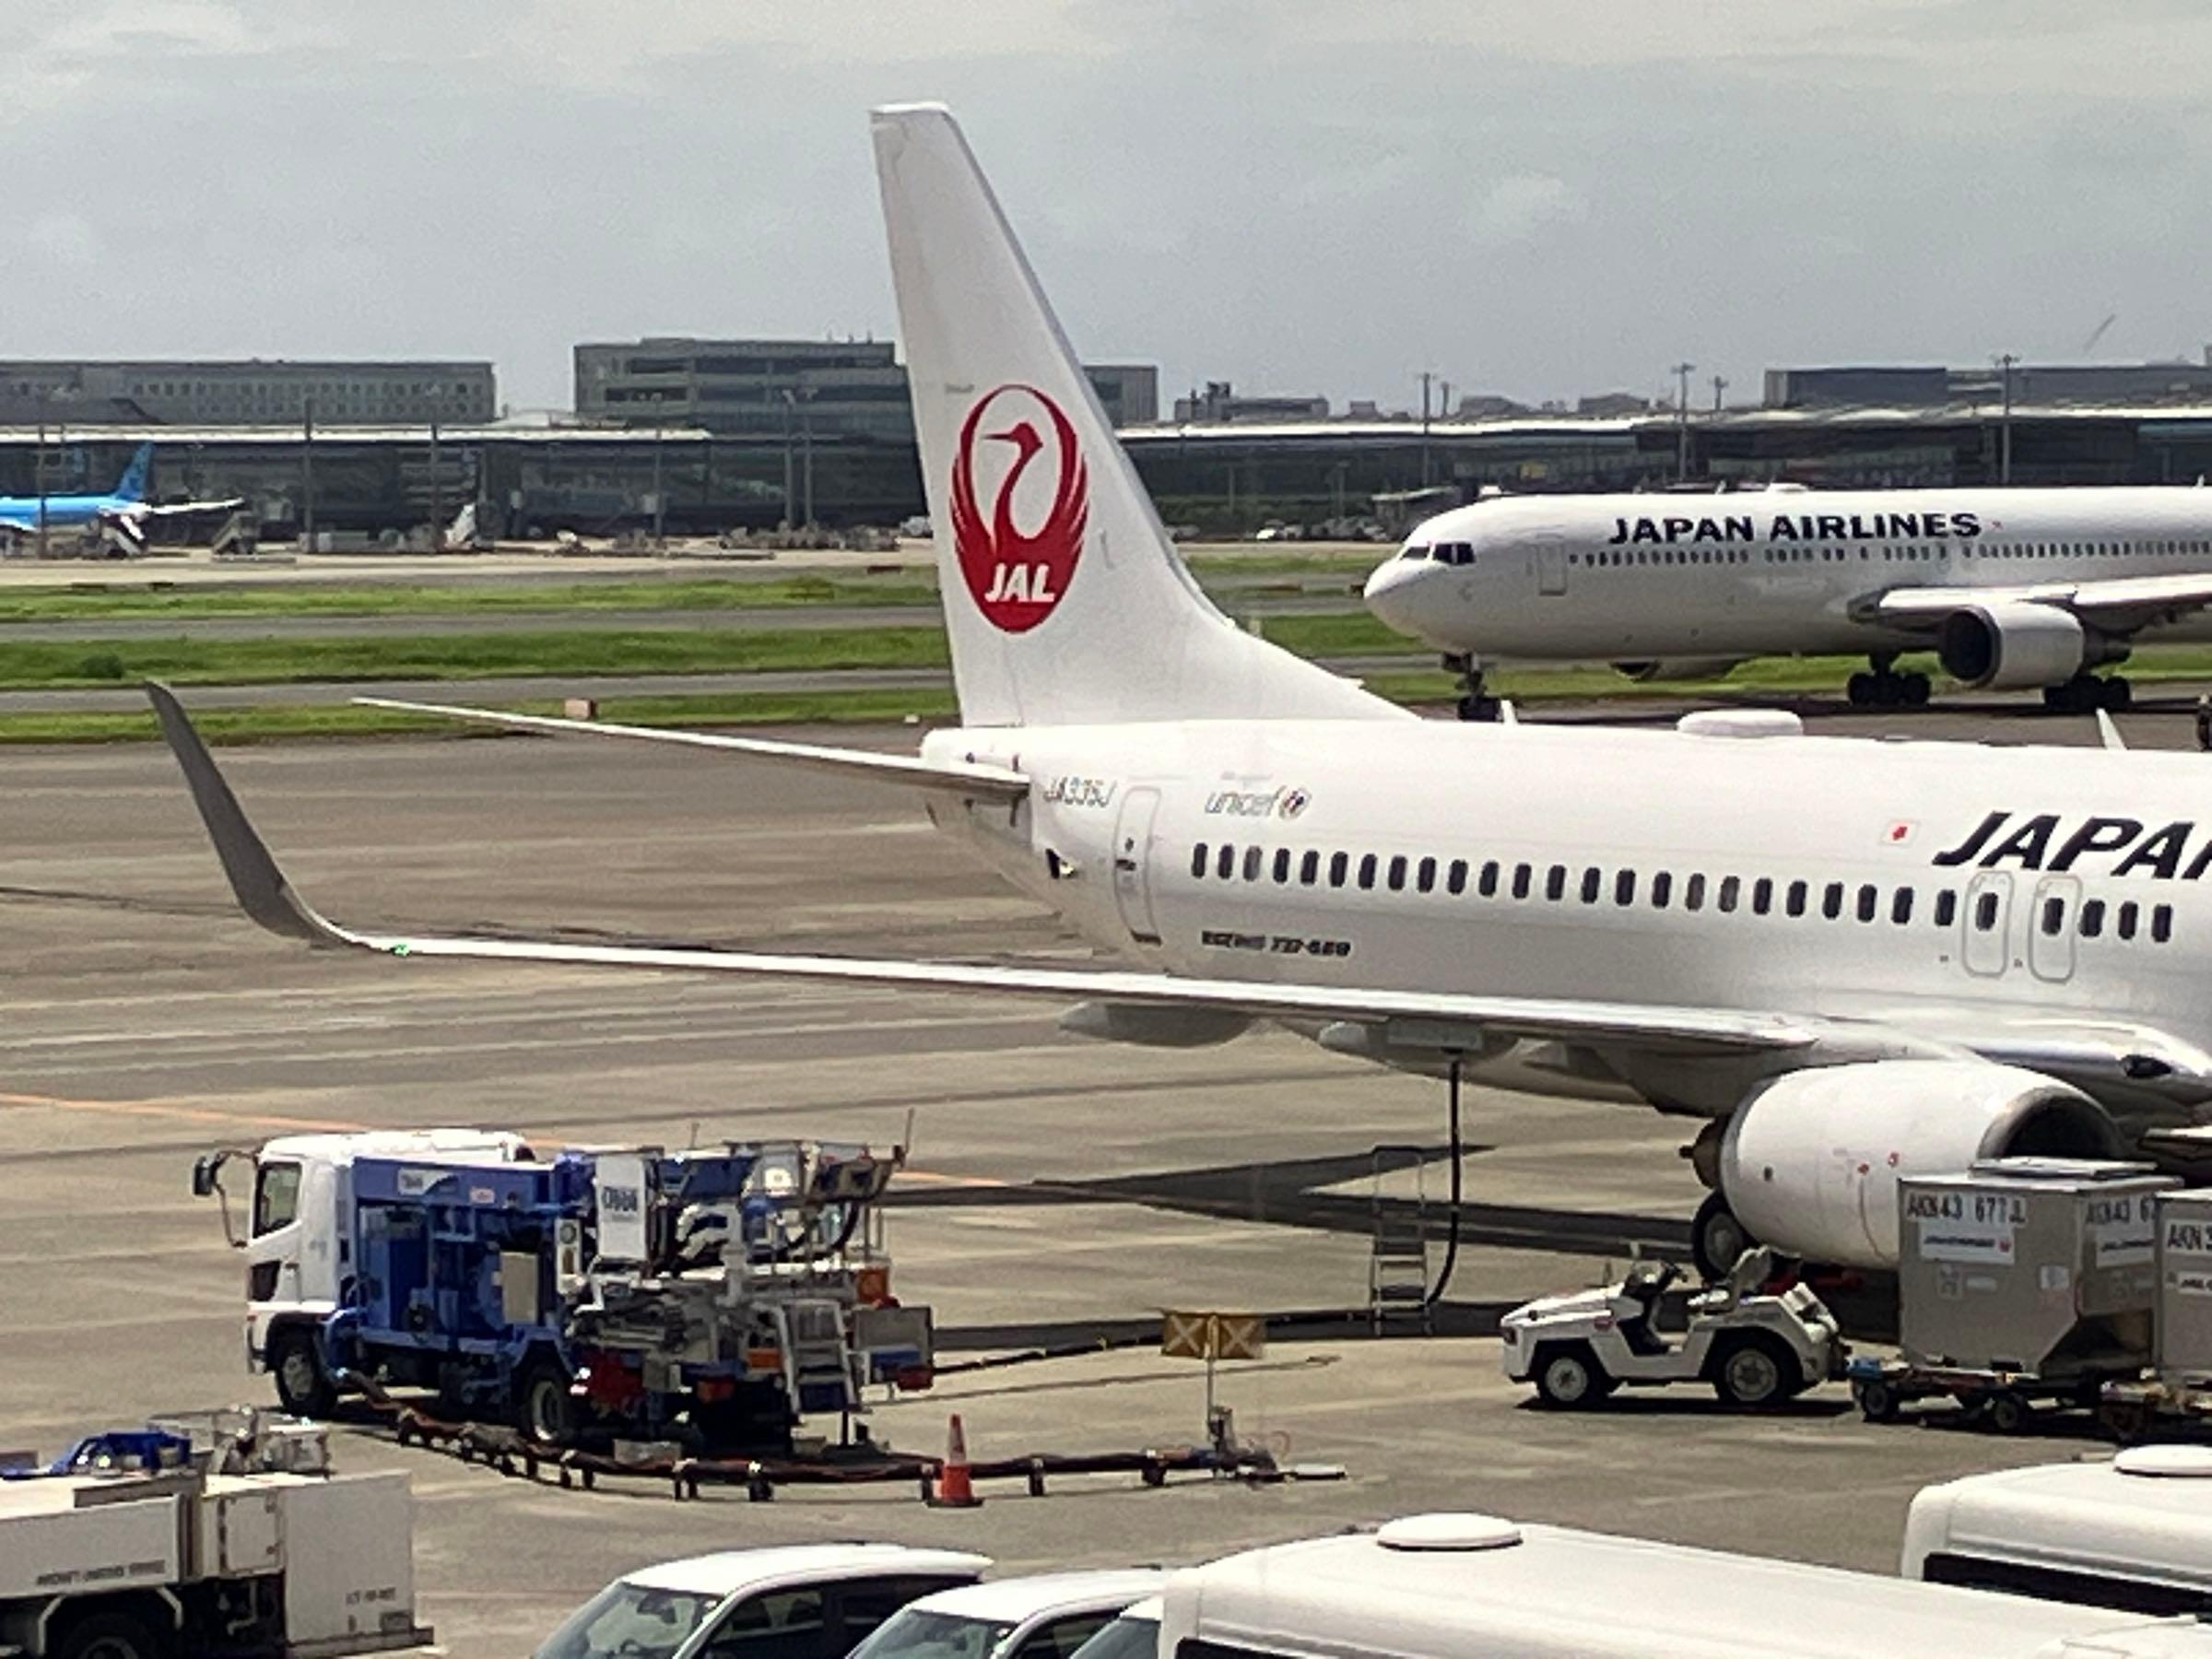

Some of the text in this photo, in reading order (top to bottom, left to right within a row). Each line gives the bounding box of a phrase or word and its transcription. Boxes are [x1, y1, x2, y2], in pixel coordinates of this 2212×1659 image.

[1608, 512, 1982, 545] JAPAN AIRLINES
[984, 562, 1055, 603] JAL
